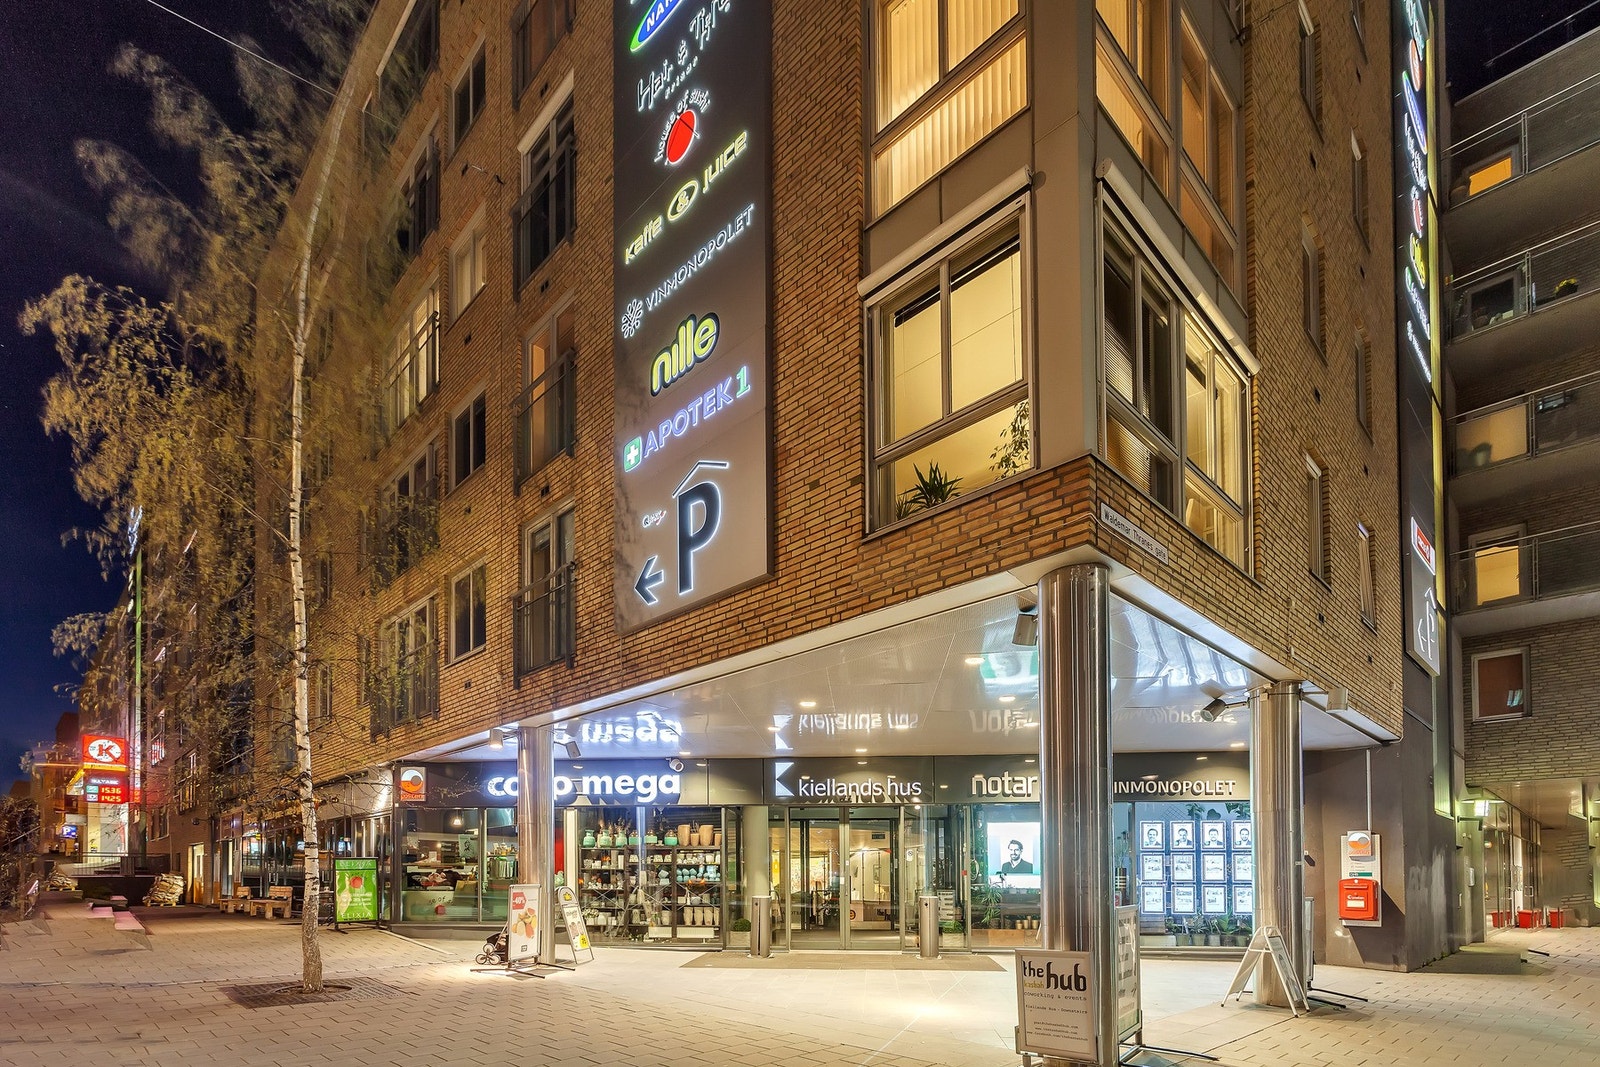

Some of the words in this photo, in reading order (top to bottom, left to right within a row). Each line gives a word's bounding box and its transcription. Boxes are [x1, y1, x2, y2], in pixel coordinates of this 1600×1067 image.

[637, 59, 673, 112] Hair
[645, 203, 754, 312] VINMONOPOLET
[651, 314, 718, 395] nille
[642, 376, 734, 458] APOTEK
[736, 364, 750, 399] 1
[677, 480, 721, 596] P
[98, 744, 119, 762] K
[487, 775, 573, 801] cop
[582, 774, 680, 802] mega
[798, 778, 882, 797] kiellands
[887, 779, 922, 796] hus
[971, 771, 1038, 795] notar
[1113, 780, 1237, 795] INMONOPOLET
[1022, 960, 1045, 978] the
[1046, 961, 1087, 991] hub
